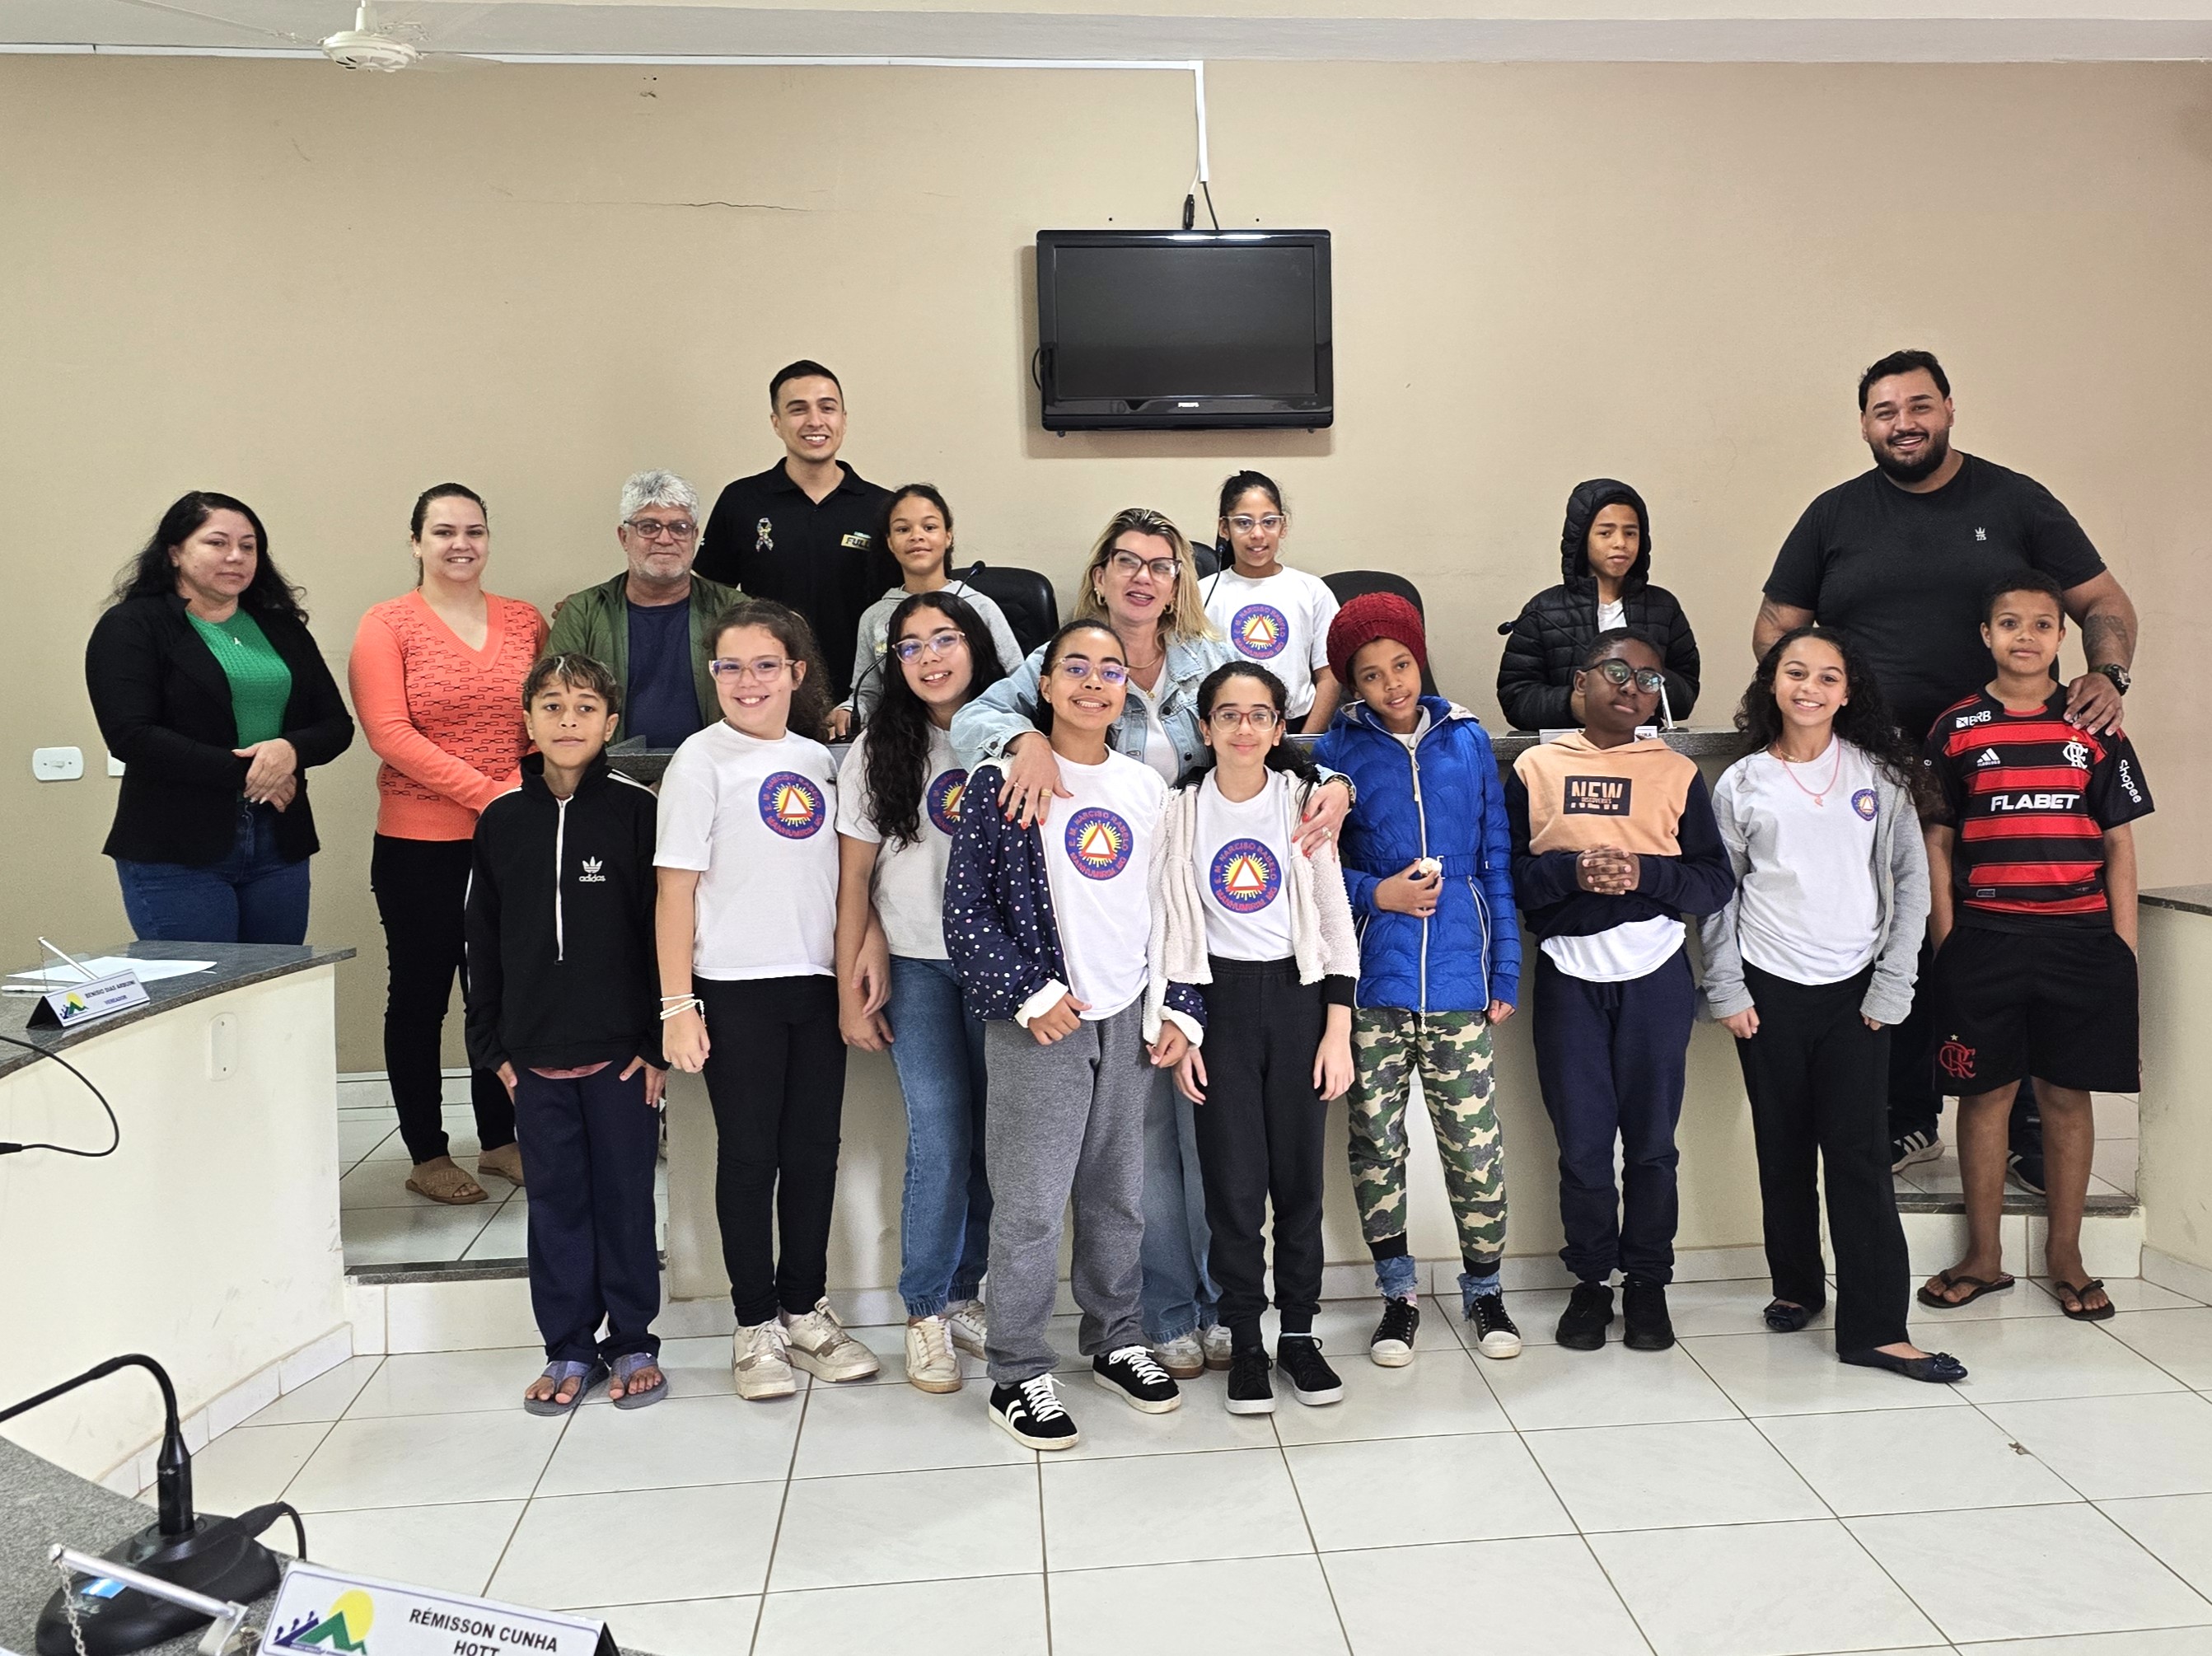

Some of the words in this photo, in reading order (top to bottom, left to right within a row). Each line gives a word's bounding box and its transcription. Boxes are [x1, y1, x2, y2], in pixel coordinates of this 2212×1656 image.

[1969, 710, 1991, 726] BRB
[2119, 759, 2142, 803] Shopee
[1570, 780, 1623, 810] NEW
[1990, 793, 2080, 812] FLABET
[578, 873, 606, 882] adidas
[409, 1607, 495, 1639] RÉMISSON
[499, 1626, 558, 1653] CUNHA
[453, 1640, 500, 1656] HOTT
